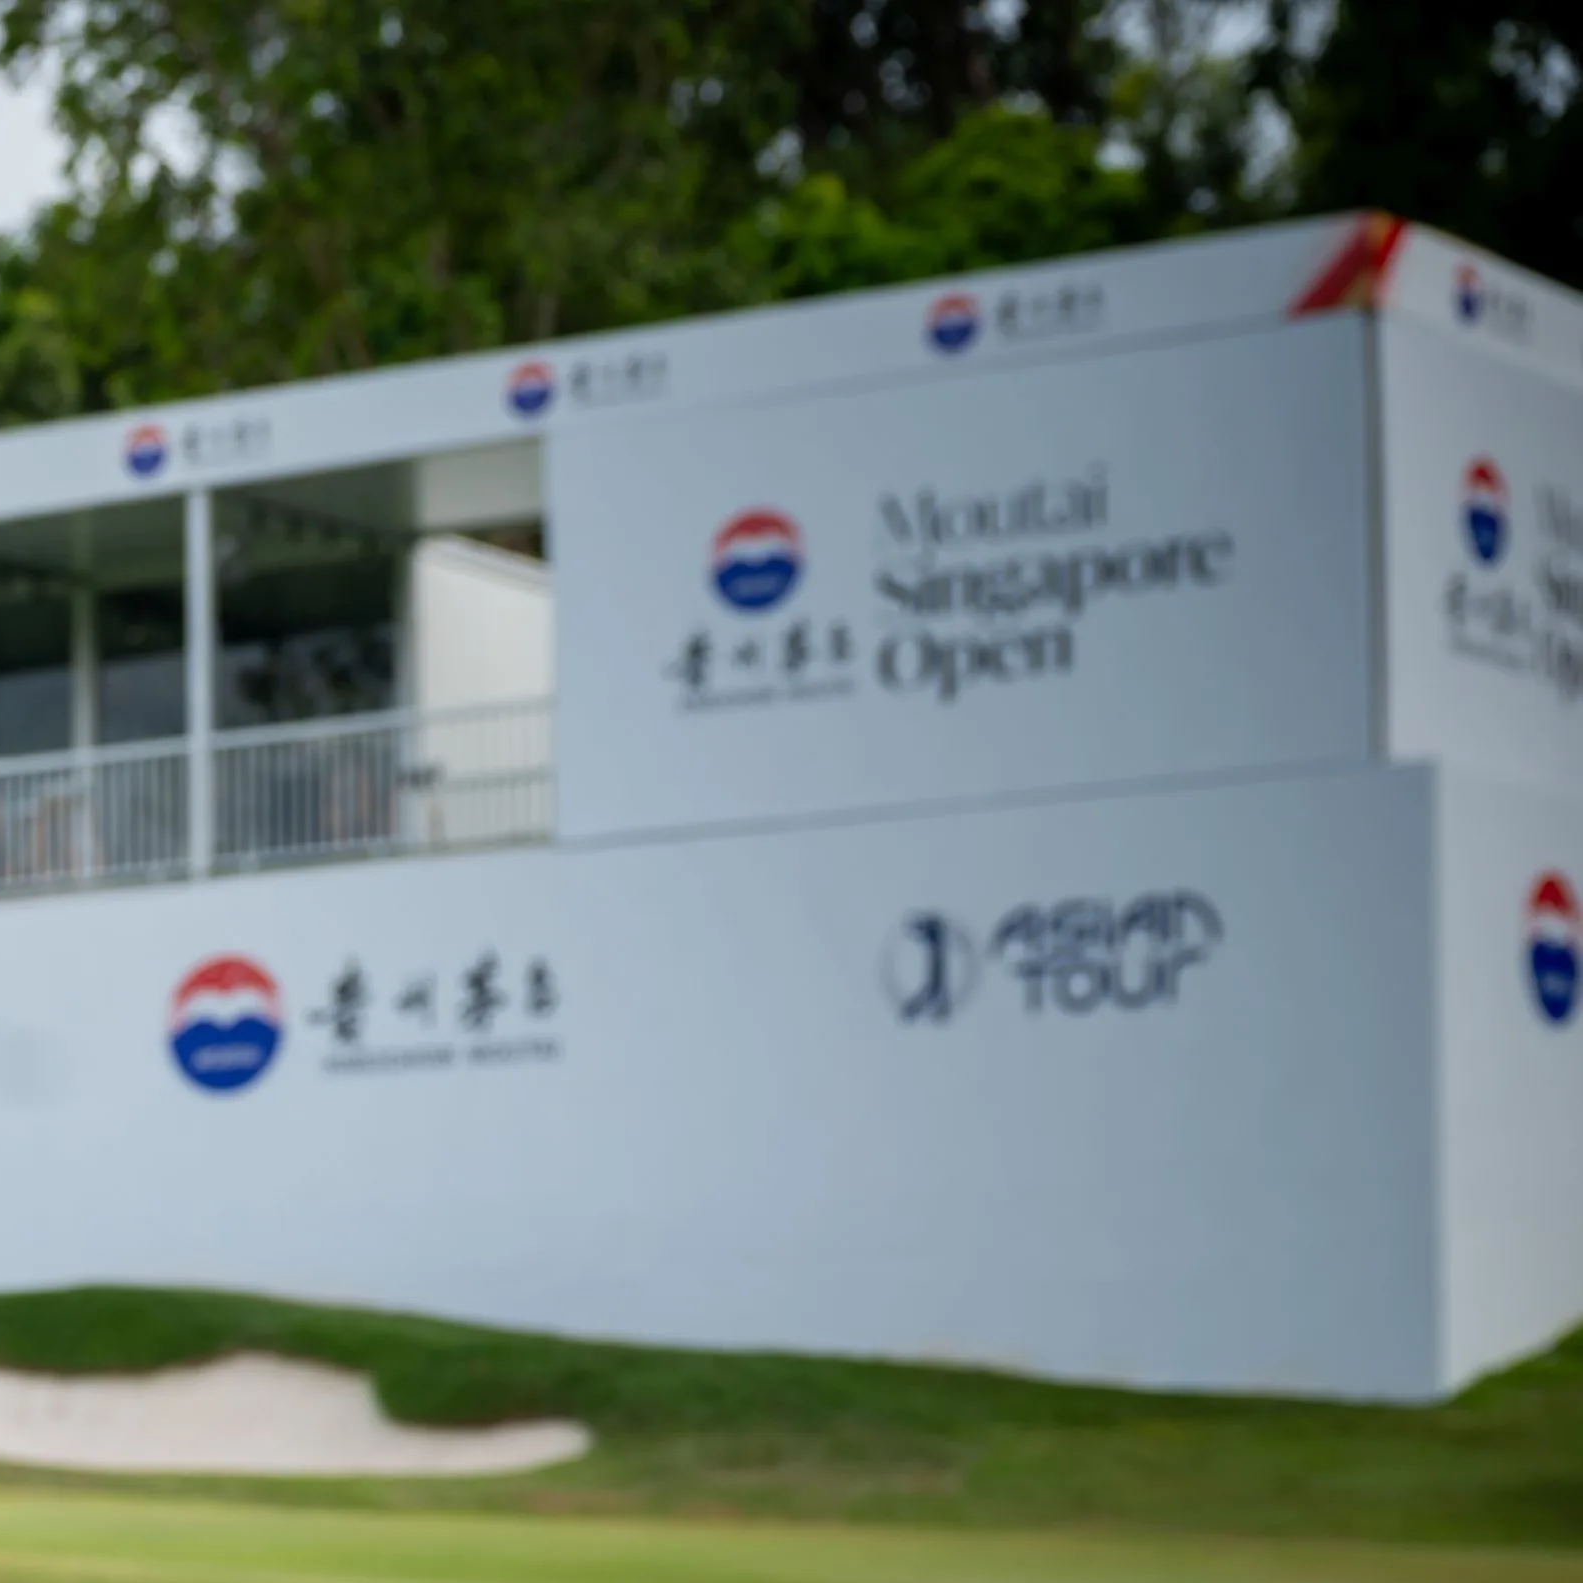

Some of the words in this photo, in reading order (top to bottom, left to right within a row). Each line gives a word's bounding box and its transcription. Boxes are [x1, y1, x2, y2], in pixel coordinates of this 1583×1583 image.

[878, 460, 1109, 543] Moutai
[873, 527, 1235, 618] Singapore
[876, 626, 1074, 703] Open
[1011, 947, 1213, 1014] TOUR
